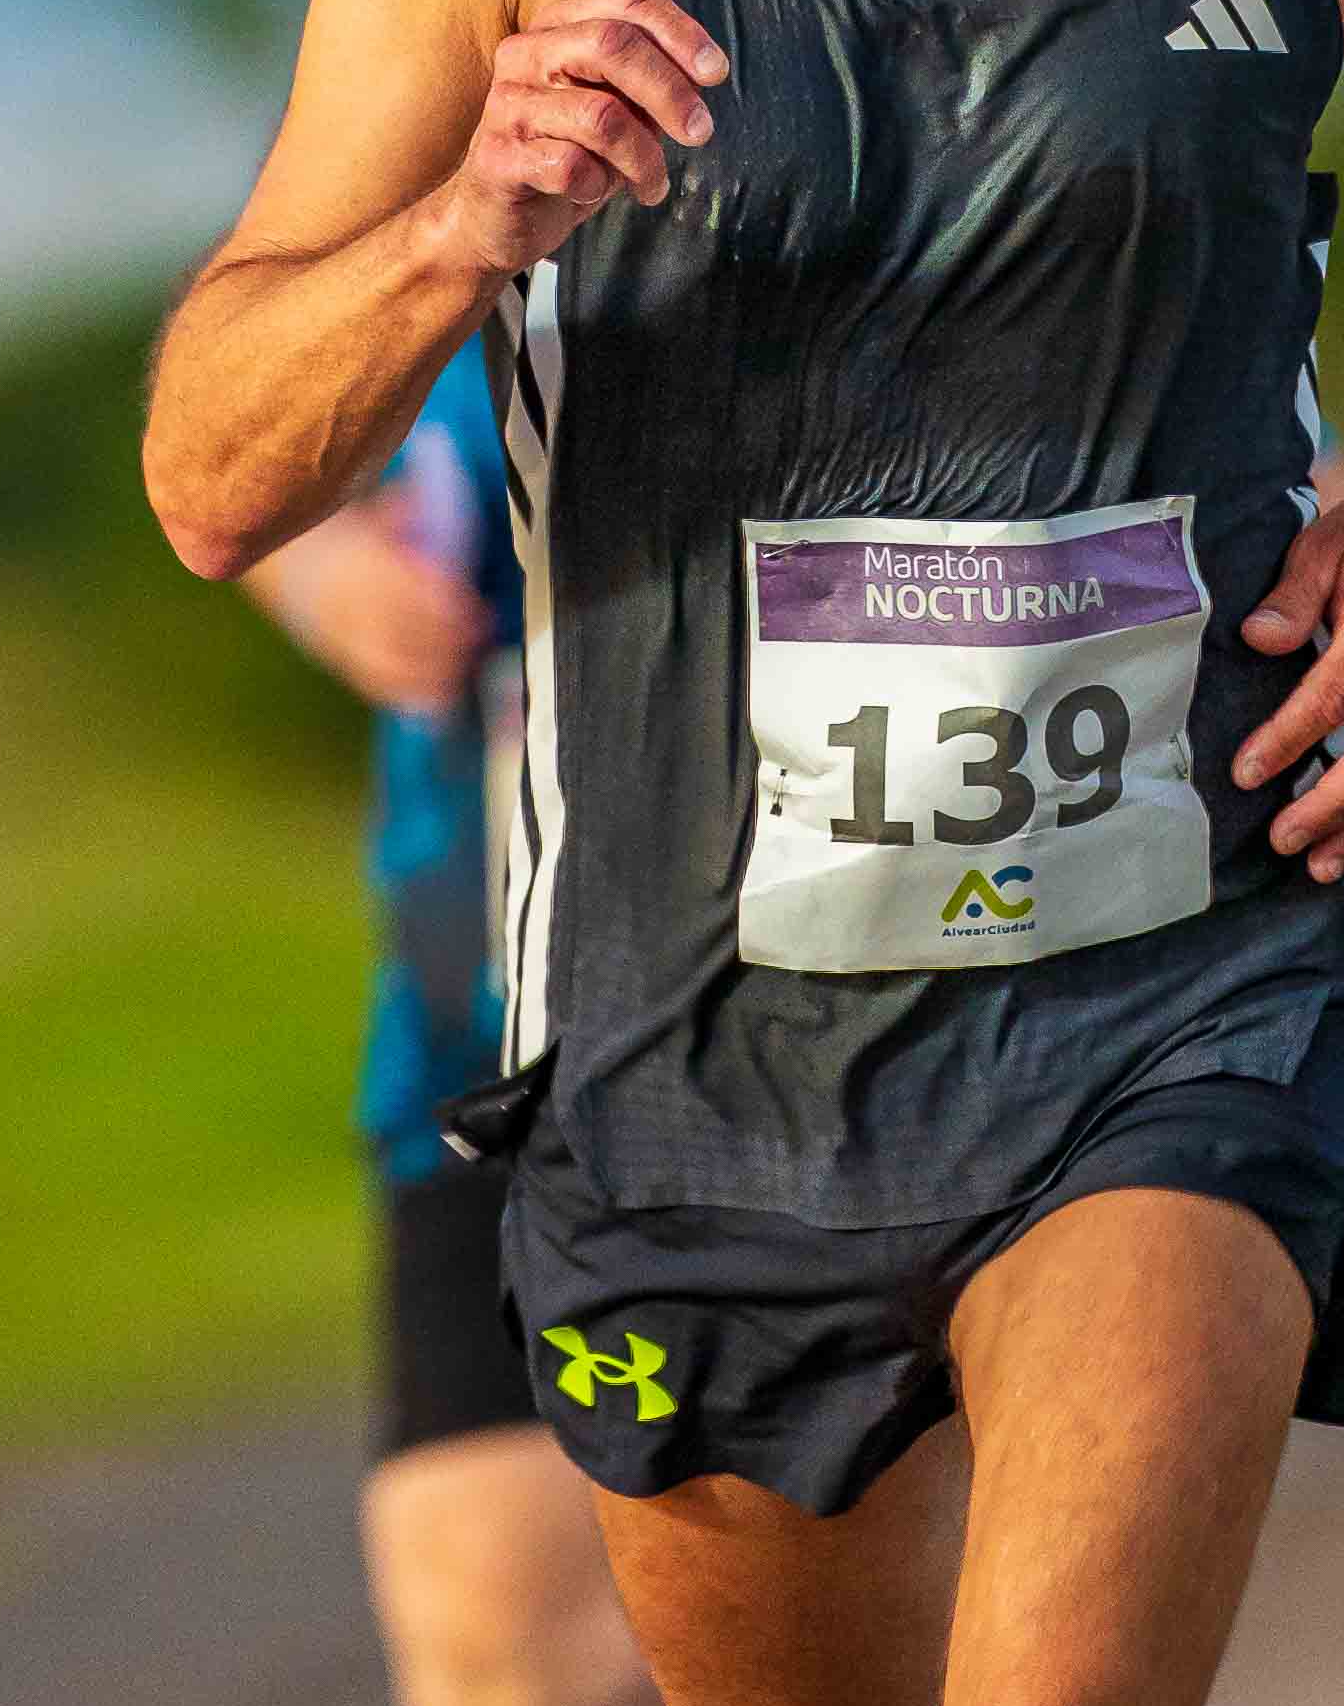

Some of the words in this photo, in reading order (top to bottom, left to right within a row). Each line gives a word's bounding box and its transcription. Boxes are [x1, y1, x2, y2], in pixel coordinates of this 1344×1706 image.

[864, 545, 1003, 580] Maratón
[865, 576, 1105, 623] NOCTURNA
[827, 684, 1131, 847] 139
[942, 920, 1036, 937] AlvearCiudad
